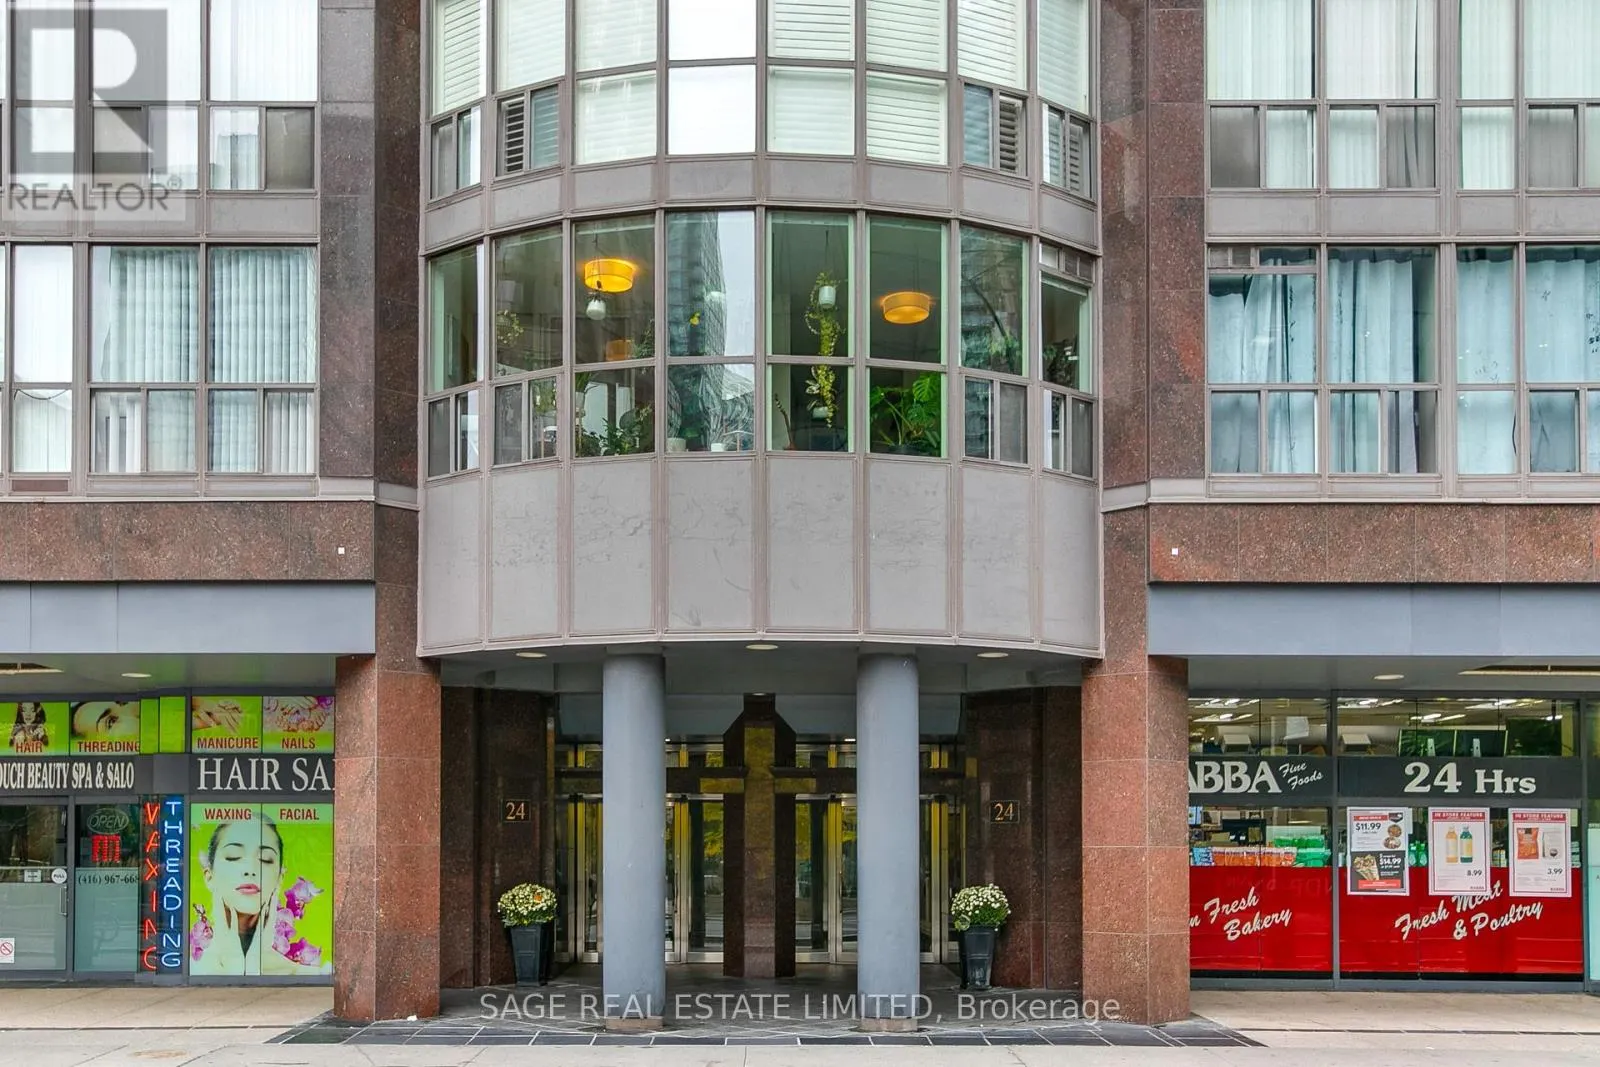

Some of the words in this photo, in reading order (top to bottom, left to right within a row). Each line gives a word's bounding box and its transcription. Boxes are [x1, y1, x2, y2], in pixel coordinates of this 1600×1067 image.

[15, 741, 43, 753] HAIR
[197, 737, 259, 750] MANICURE
[281, 737, 316, 750] NAILS
[27, 762, 70, 789] BEAUTY
[72, 762, 93, 789] SPA
[95, 762, 104, 789] &
[106, 762, 135, 789] SALO
[197, 757, 282, 791] HAIR
[291, 757, 335, 792] SA
[1279, 763, 1307, 778] Fine
[1287, 770, 1324, 790] Foods
[1404, 762, 1462, 793] 24
[1475, 769, 1537, 794] Hrs
[204, 808, 252, 820] WAXING
[279, 808, 319, 820] FACIAL
[506, 802, 526, 820] 24
[994, 803, 1015, 820] 24
[89, 815, 127, 828] OPEN
[161, 801, 183, 968] THREADING
[1203, 886, 1260, 924] Fresh
[1223, 908, 1293, 942] Bakery
[1394, 900, 1450, 941] Fresh
[1453, 919, 1468, 941] &
[1470, 901, 1543, 936] Poultry
